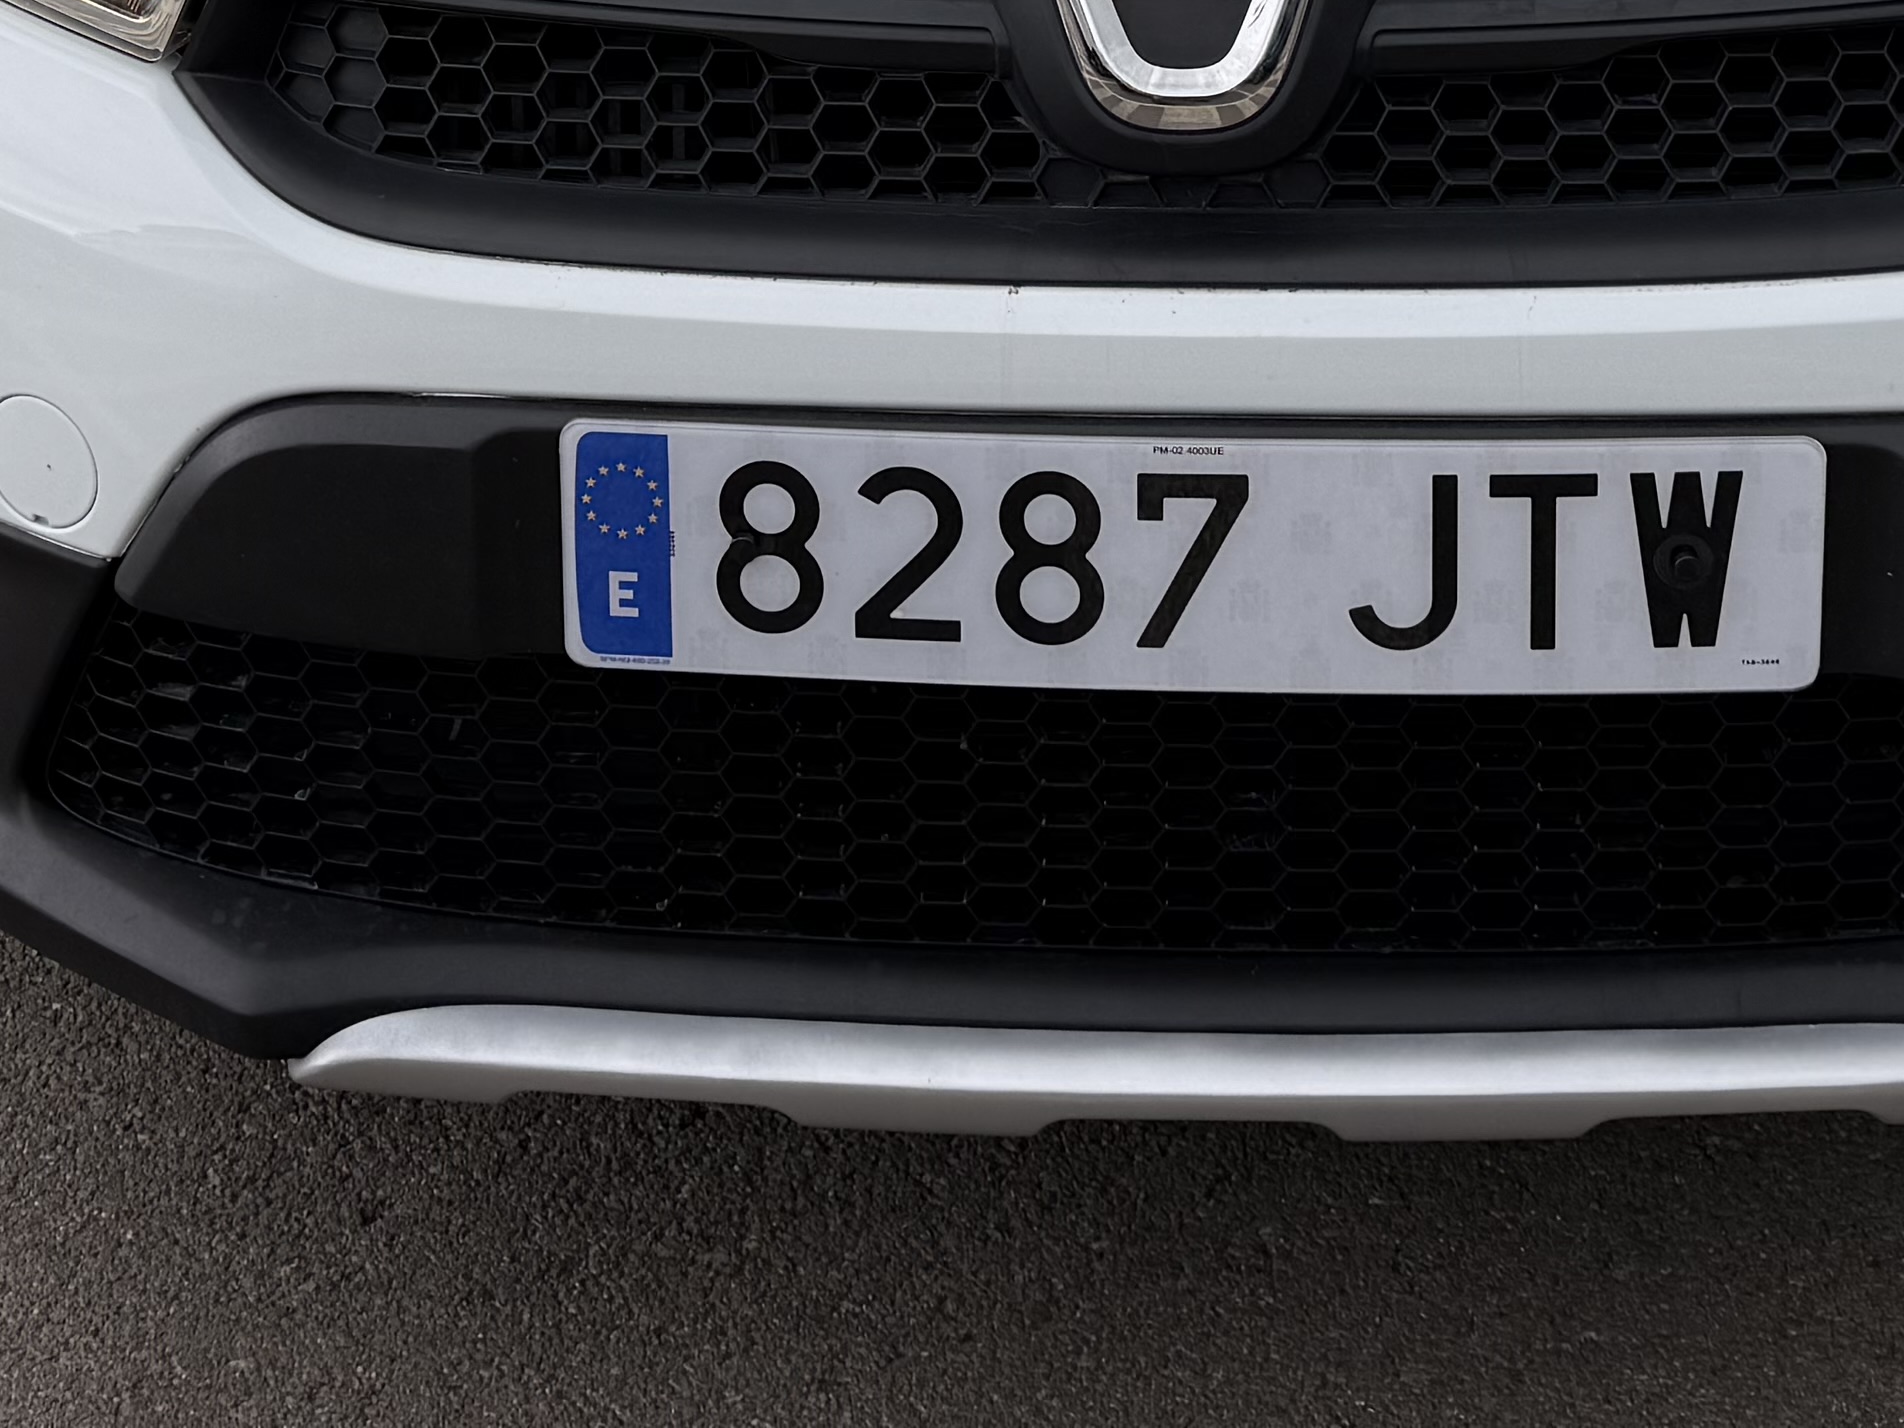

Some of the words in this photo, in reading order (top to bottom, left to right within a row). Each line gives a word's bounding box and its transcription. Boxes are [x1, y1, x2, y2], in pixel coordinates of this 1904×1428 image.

[608, 570, 641, 618] E
[716, 460, 1249, 649] 8287
[1348, 470, 1745, 651] JTW
